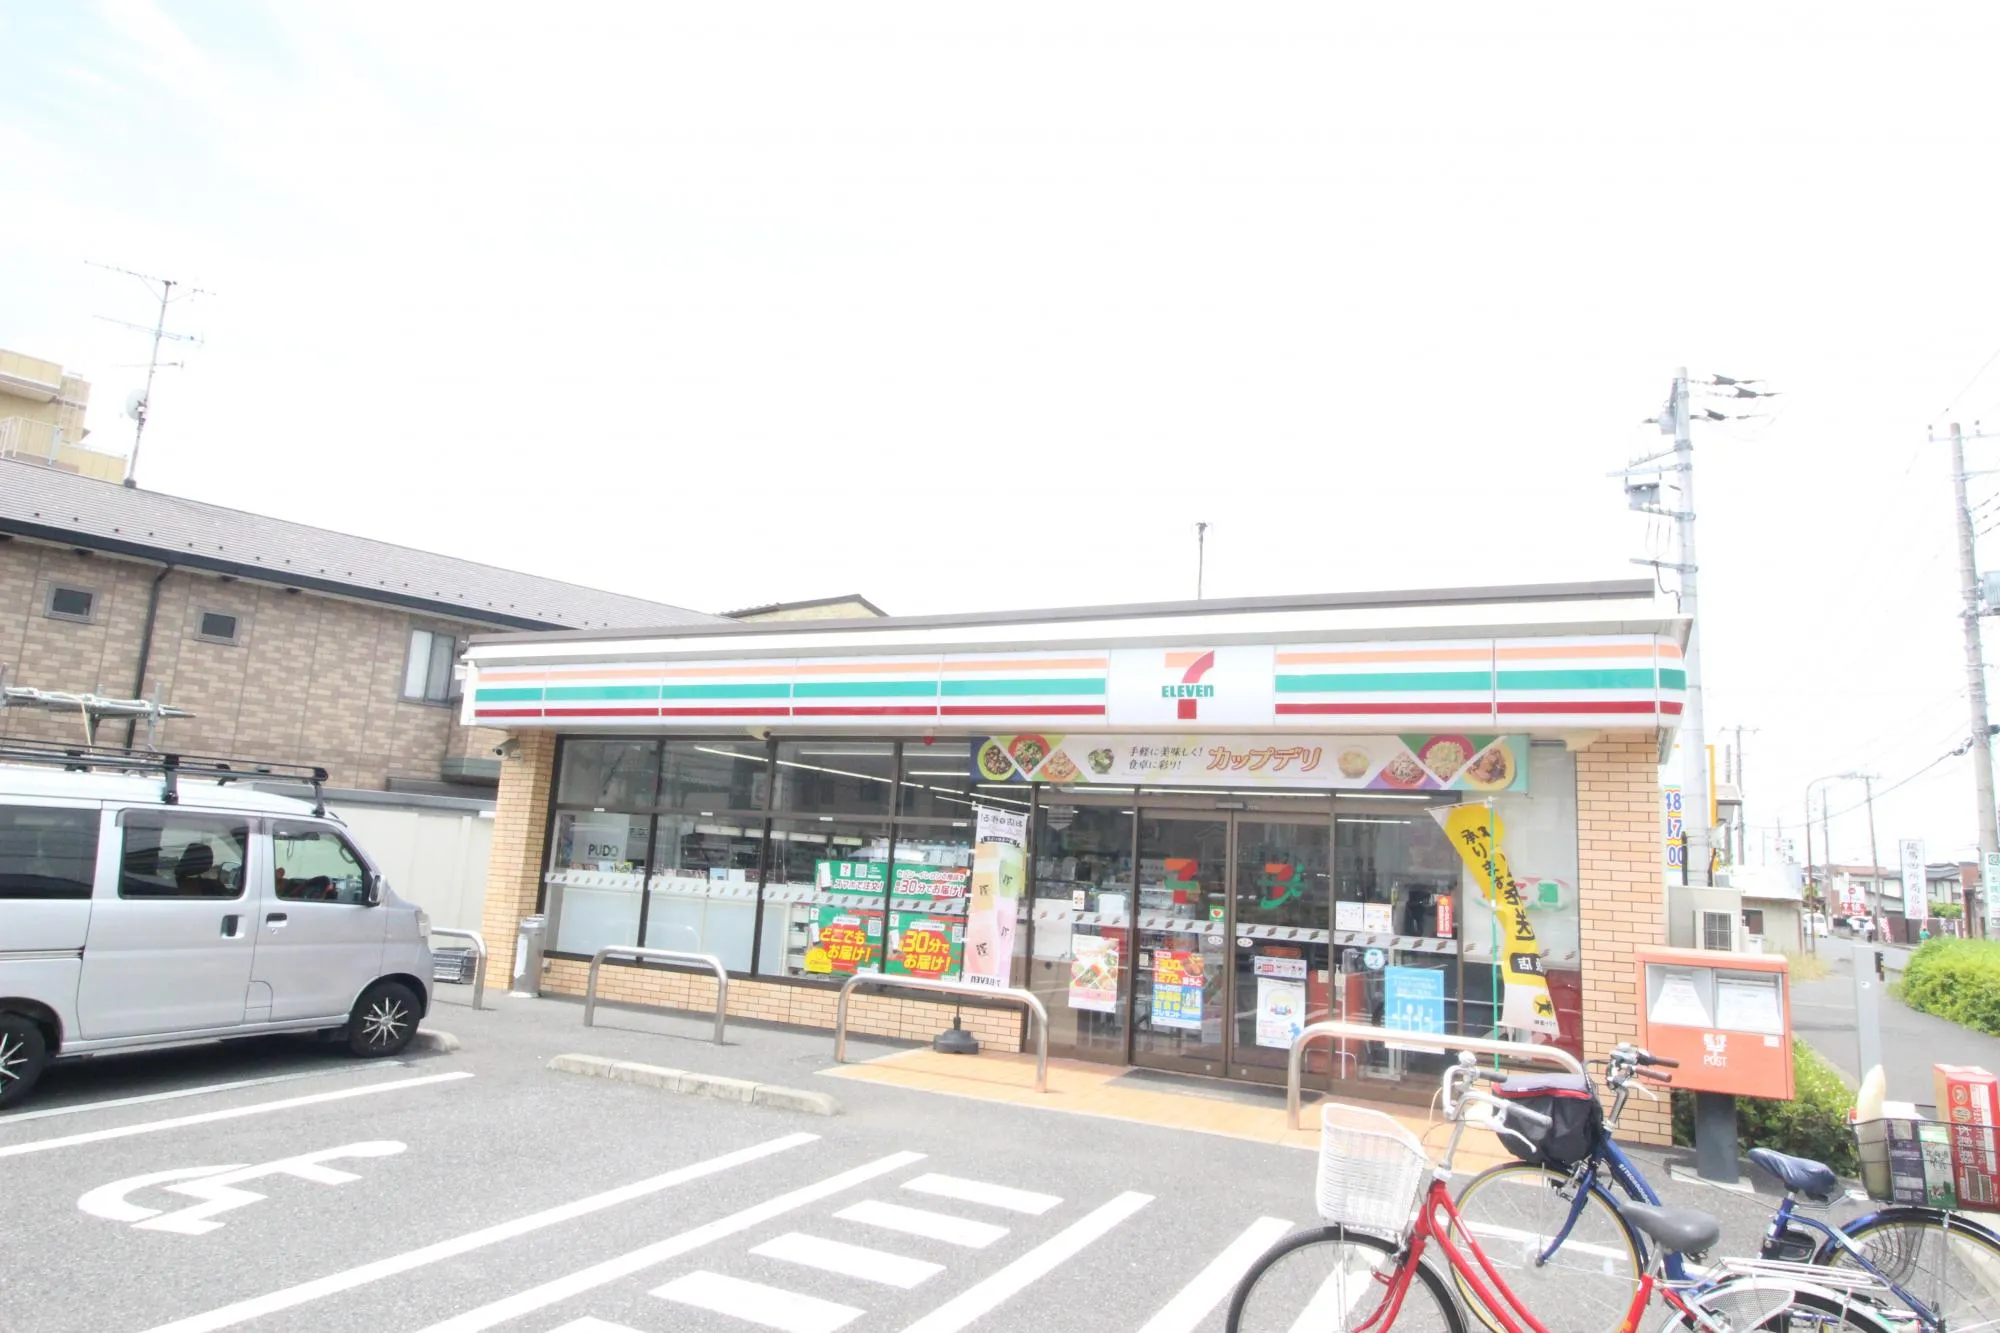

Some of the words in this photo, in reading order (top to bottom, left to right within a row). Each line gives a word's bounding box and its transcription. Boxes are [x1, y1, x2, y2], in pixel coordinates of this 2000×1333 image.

[1161, 684, 1214, 698] ELEVEN
[1206, 746, 1322, 772] カップデリ
[588, 843, 620, 857] PUDO
[820, 927, 866, 945] どこでも
[827, 944, 872, 963] お届け!
[903, 953, 952, 973] お届け!
[1703, 1055, 1727, 1067] POST
